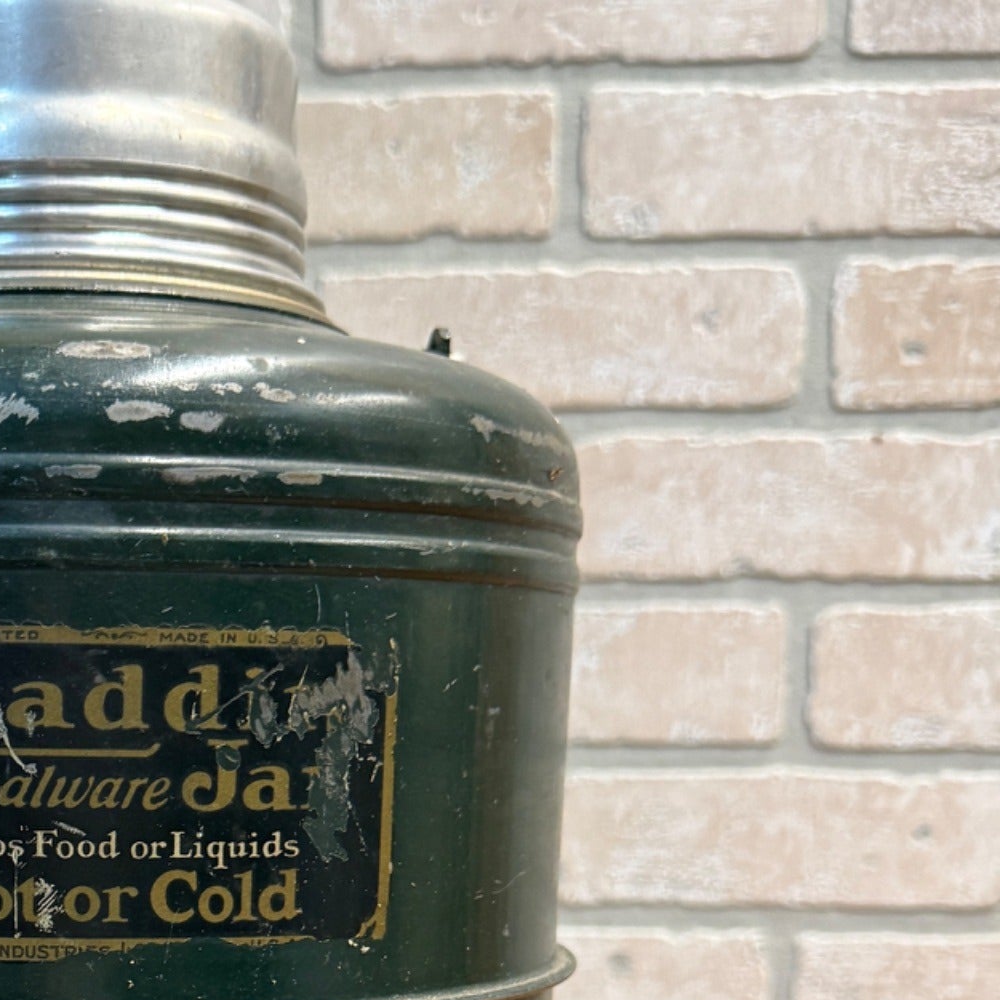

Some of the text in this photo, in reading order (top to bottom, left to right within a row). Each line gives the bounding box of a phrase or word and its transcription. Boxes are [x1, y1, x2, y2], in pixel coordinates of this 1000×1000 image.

[159, 632, 209, 645] MADE
[220, 632, 237, 645] IN
[32, 830, 120, 860] Food
[130, 839, 167, 860] or
[169, 831, 300, 870] Liquids
[63, 885, 139, 923] or
[150, 869, 302, 924] Cold
